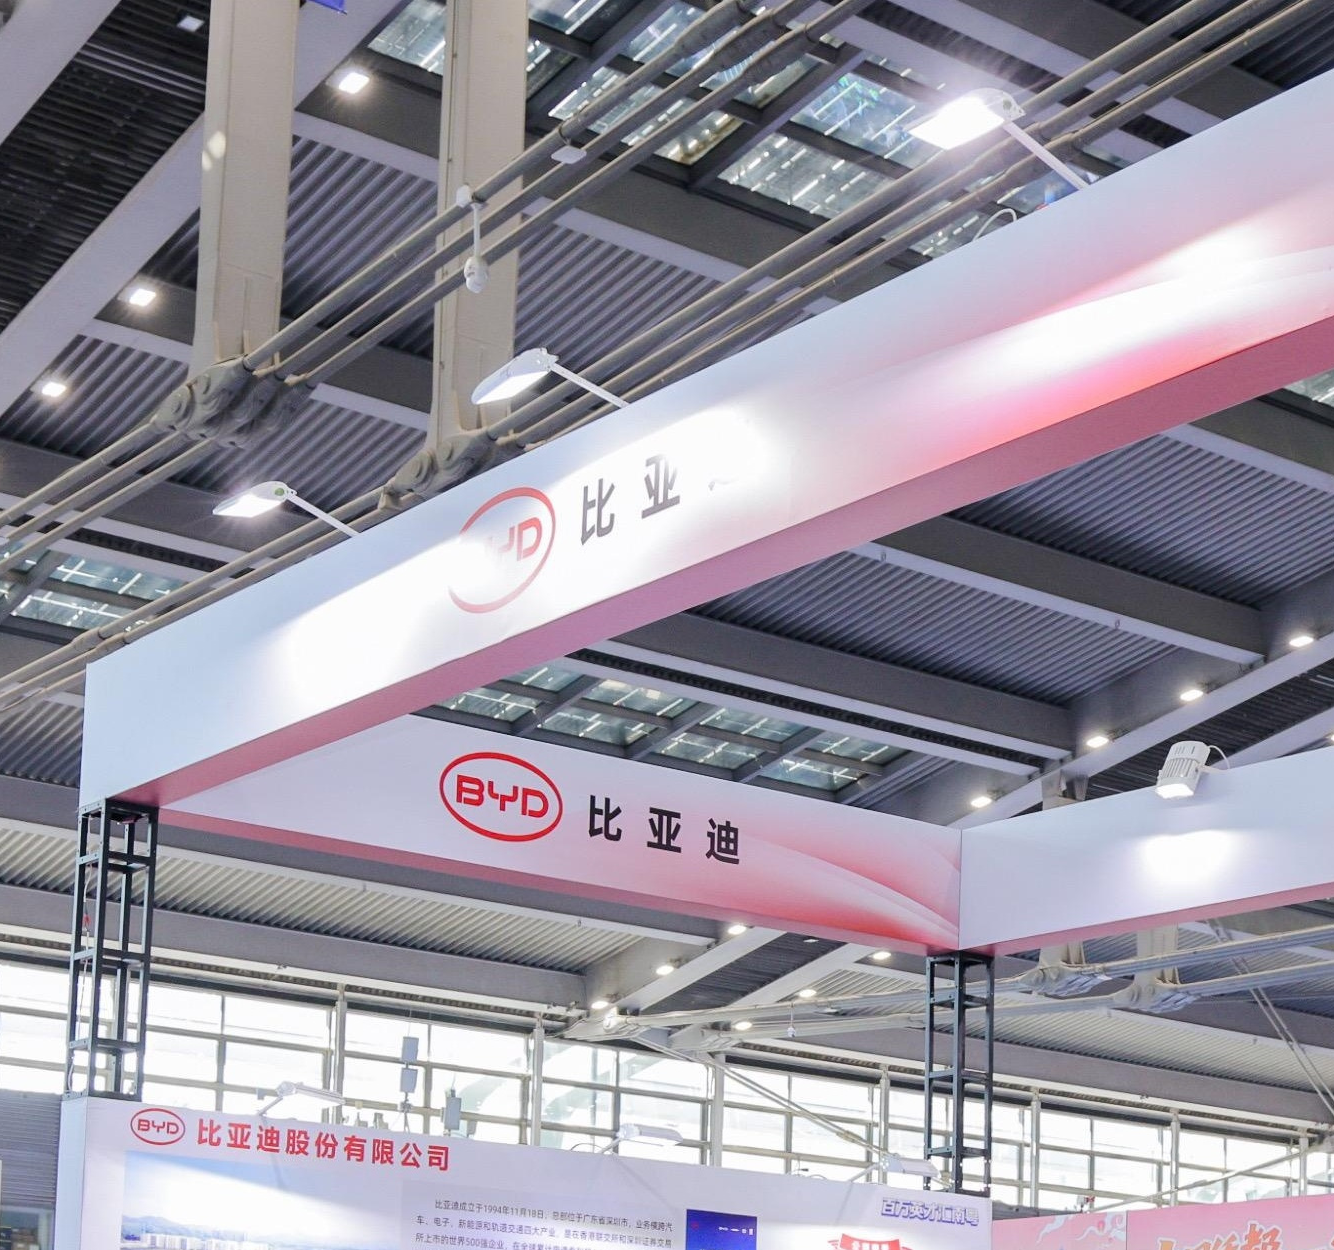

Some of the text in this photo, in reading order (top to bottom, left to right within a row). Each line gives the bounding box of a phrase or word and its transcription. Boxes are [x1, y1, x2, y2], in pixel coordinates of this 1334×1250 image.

[456, 774, 740, 864] BYD 比亚迪
[137, 1118, 449, 1171] BYD 比亚迪股份有限公司
